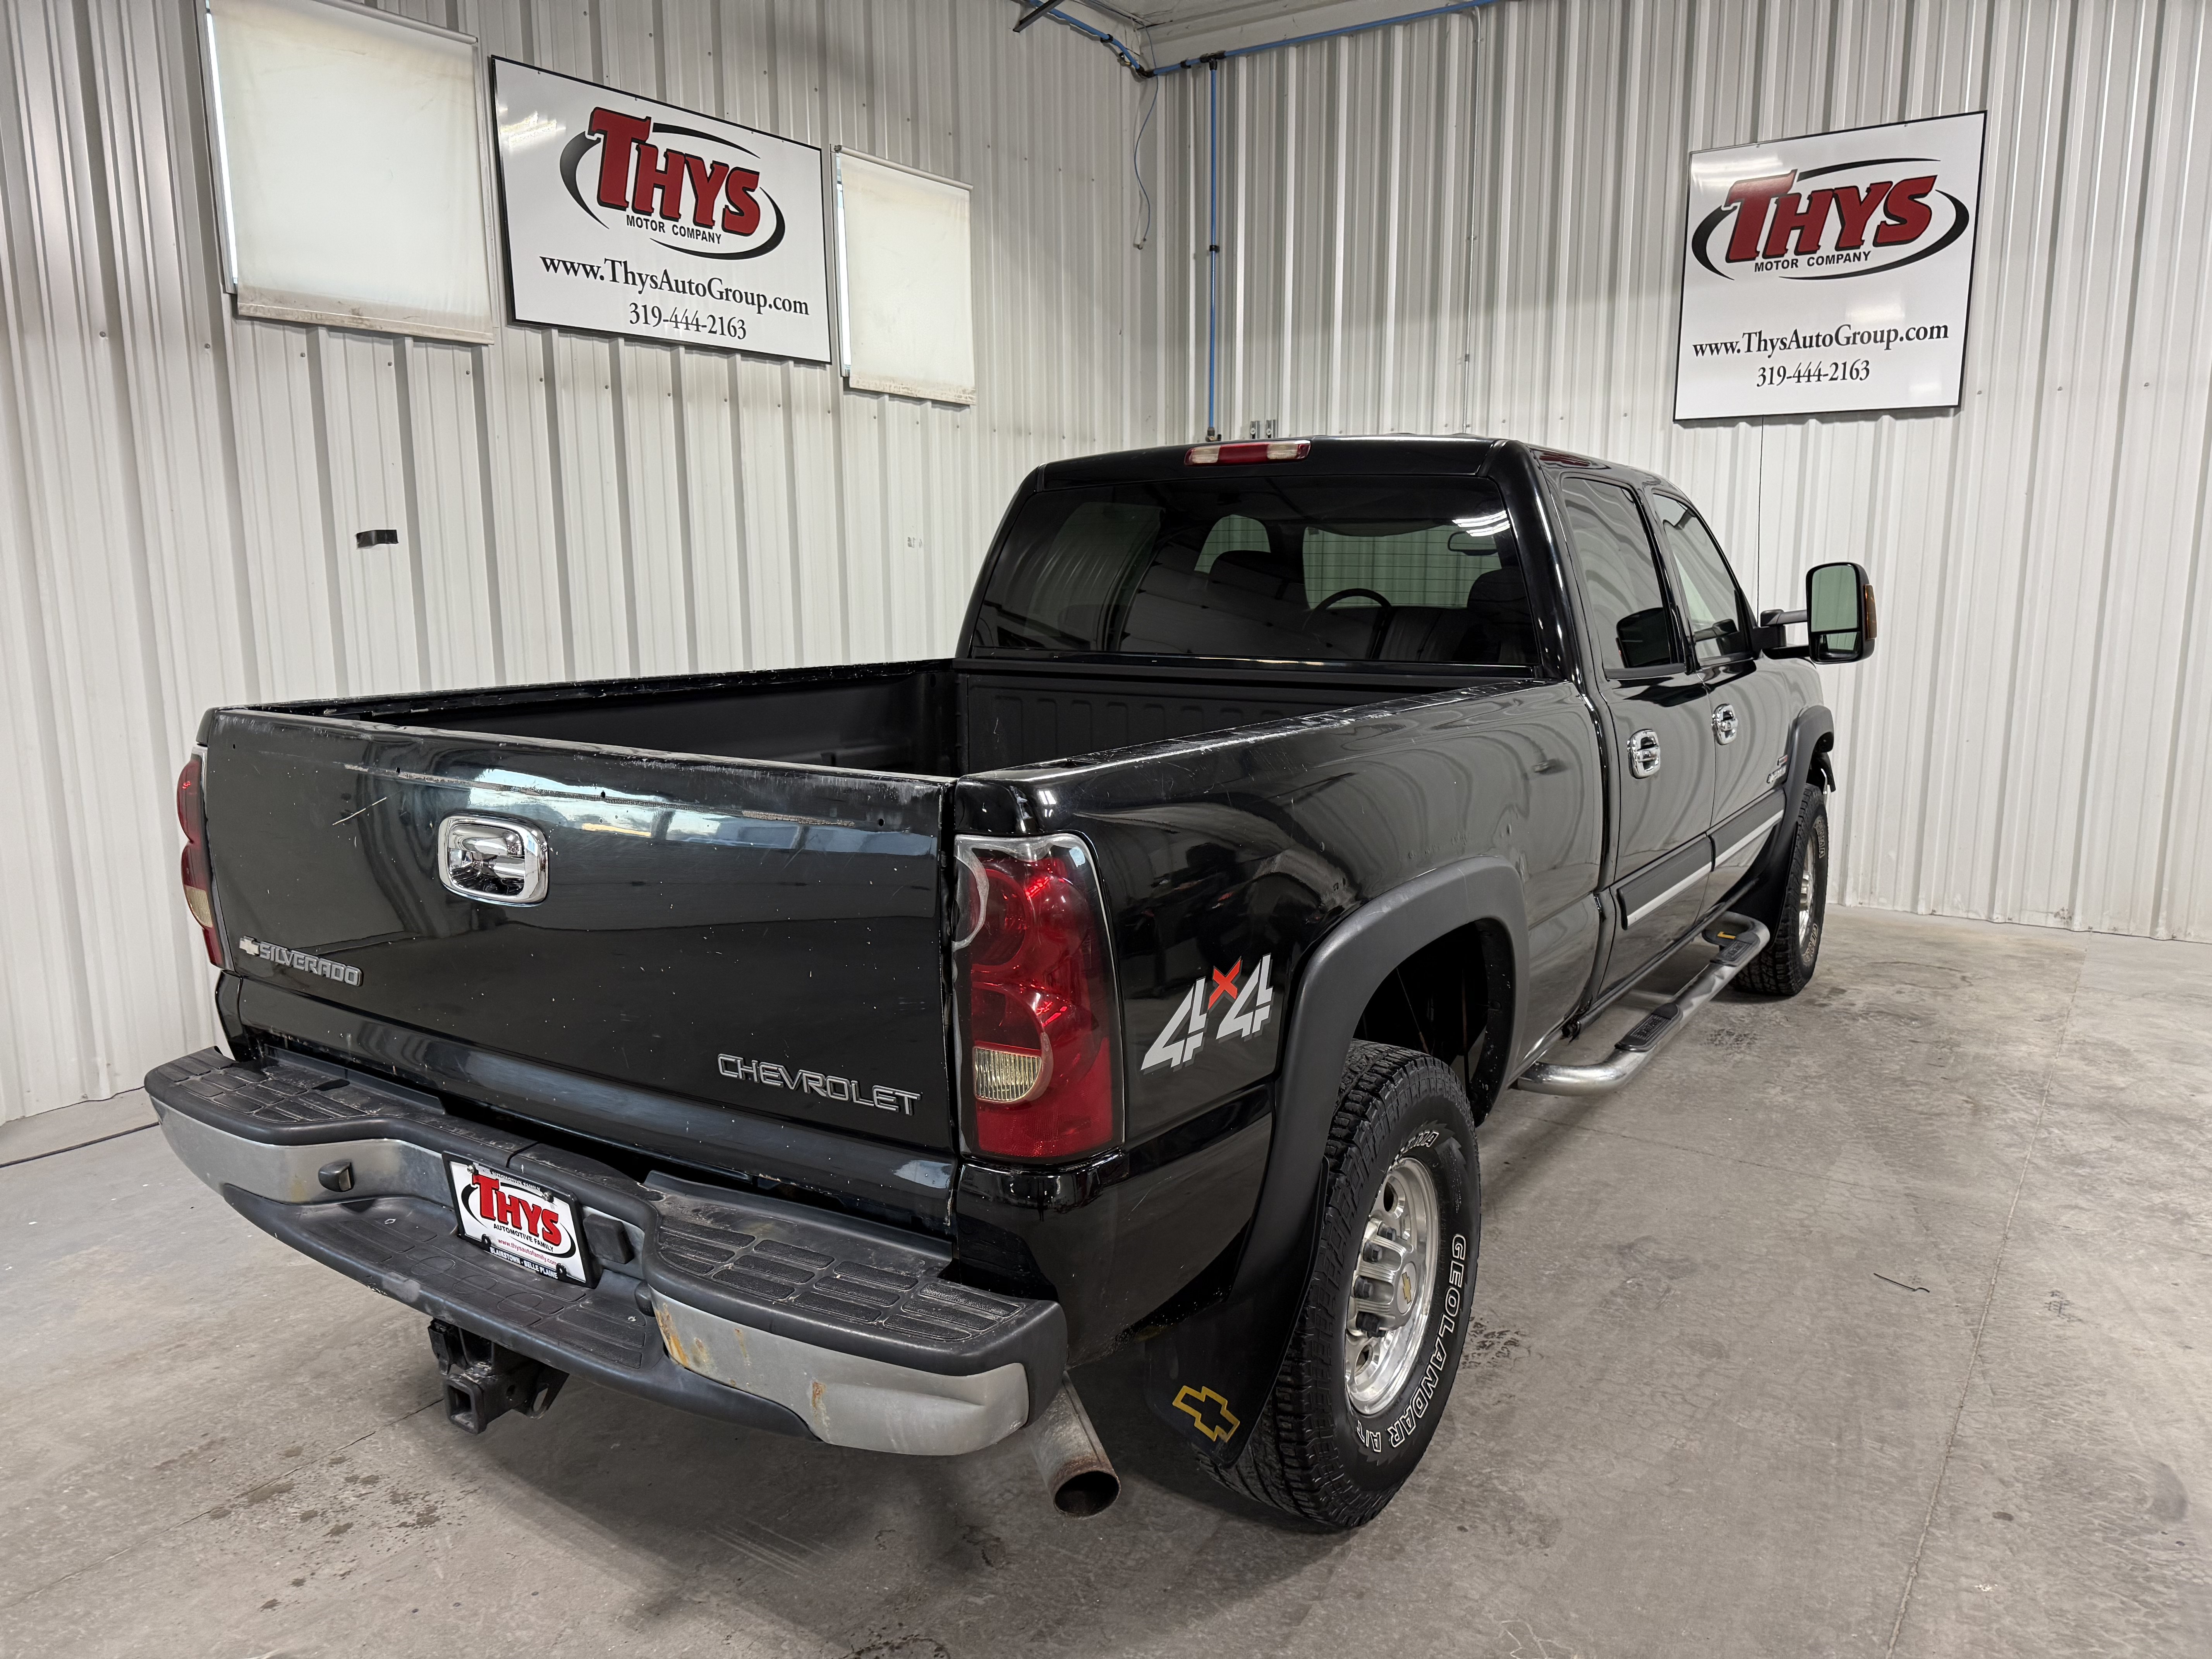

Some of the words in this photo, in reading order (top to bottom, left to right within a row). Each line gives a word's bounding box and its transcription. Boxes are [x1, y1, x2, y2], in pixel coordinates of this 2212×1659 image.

[589, 106, 760, 237] THYS
[626, 214, 666, 233] MOTOR
[672, 224, 722, 245] COMPANY
[1724, 169, 1938, 263] THYS
[1755, 258, 1799, 272] MOTOR
[1807, 251, 1871, 267] COMPANY
[539, 256, 810, 315] www.ThysAutoGroup.com
[629, 302, 747, 340] 319-444-2163
[1693, 324, 1949, 358] www.ThysAutoGroup.com
[1757, 359, 1870, 387] 319-444-2163
[259, 941, 363, 987] SILVERADO
[717, 1053, 921, 1115] CHEVROLET
[472, 1173, 562, 1246] THYS
[494, 1224, 533, 1242] AUTOMOTIVE
[534, 1238, 553, 1252] FAMILY
[490, 1247, 521, 1264] BLAIRSTOWN
[524, 1260, 539, 1272] BELLE
[539, 1266, 558, 1279] PLAINE
[1387, 1234, 1466, 1448] GEOLANDAR
